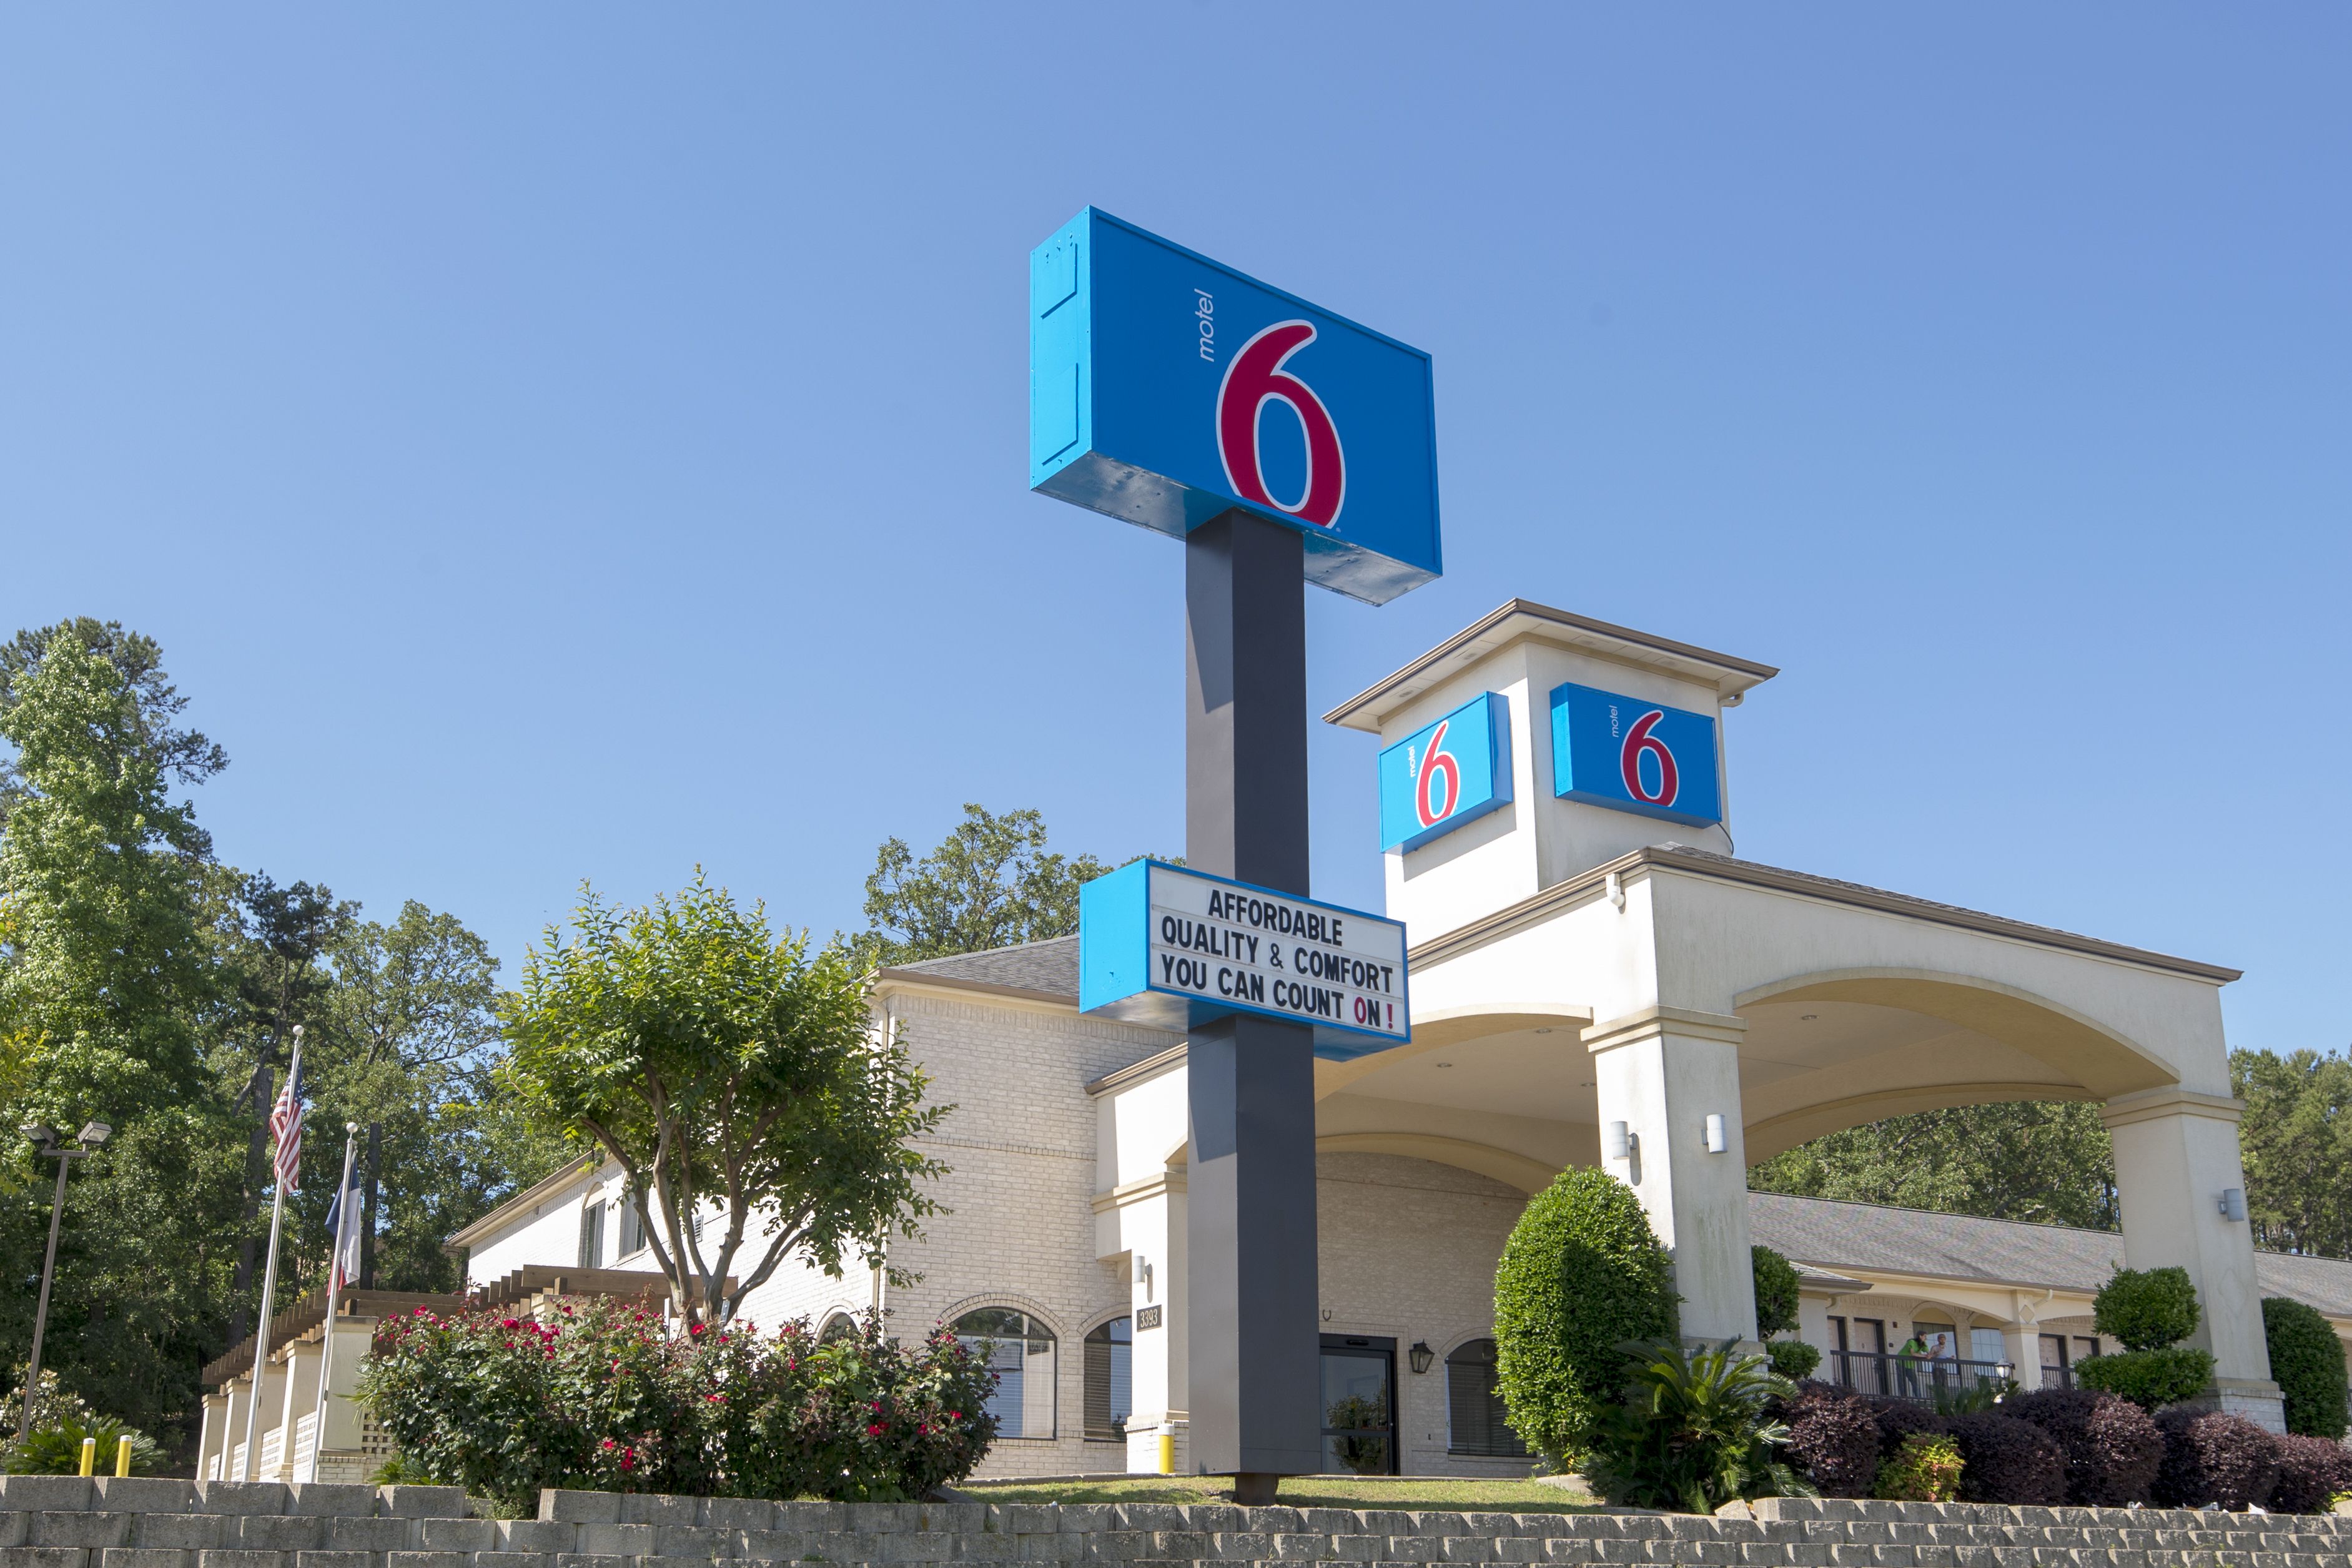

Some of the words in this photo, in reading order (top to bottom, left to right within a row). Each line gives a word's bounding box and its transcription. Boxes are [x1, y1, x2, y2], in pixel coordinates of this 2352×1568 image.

[1193, 288, 1215, 362] motel
[1215, 318, 1346, 530] 6
[1408, 744, 1416, 778] motel
[1416, 719, 1460, 829] 6
[1608, 704, 1619, 738] motel
[1620, 709, 1679, 807] 6
[1161, 915, 1259, 964] QUALITY
[1269, 942, 1284, 970] &
[1294, 946, 1393, 994] COMFORT
[1207, 889, 1343, 947] AFFORDABLE
[1161, 954, 1207, 990] YOU
[1217, 967, 1265, 1004] CAN
[1272, 979, 1345, 1020] COUNT
[1140, 1308, 1158, 1328] 3393
